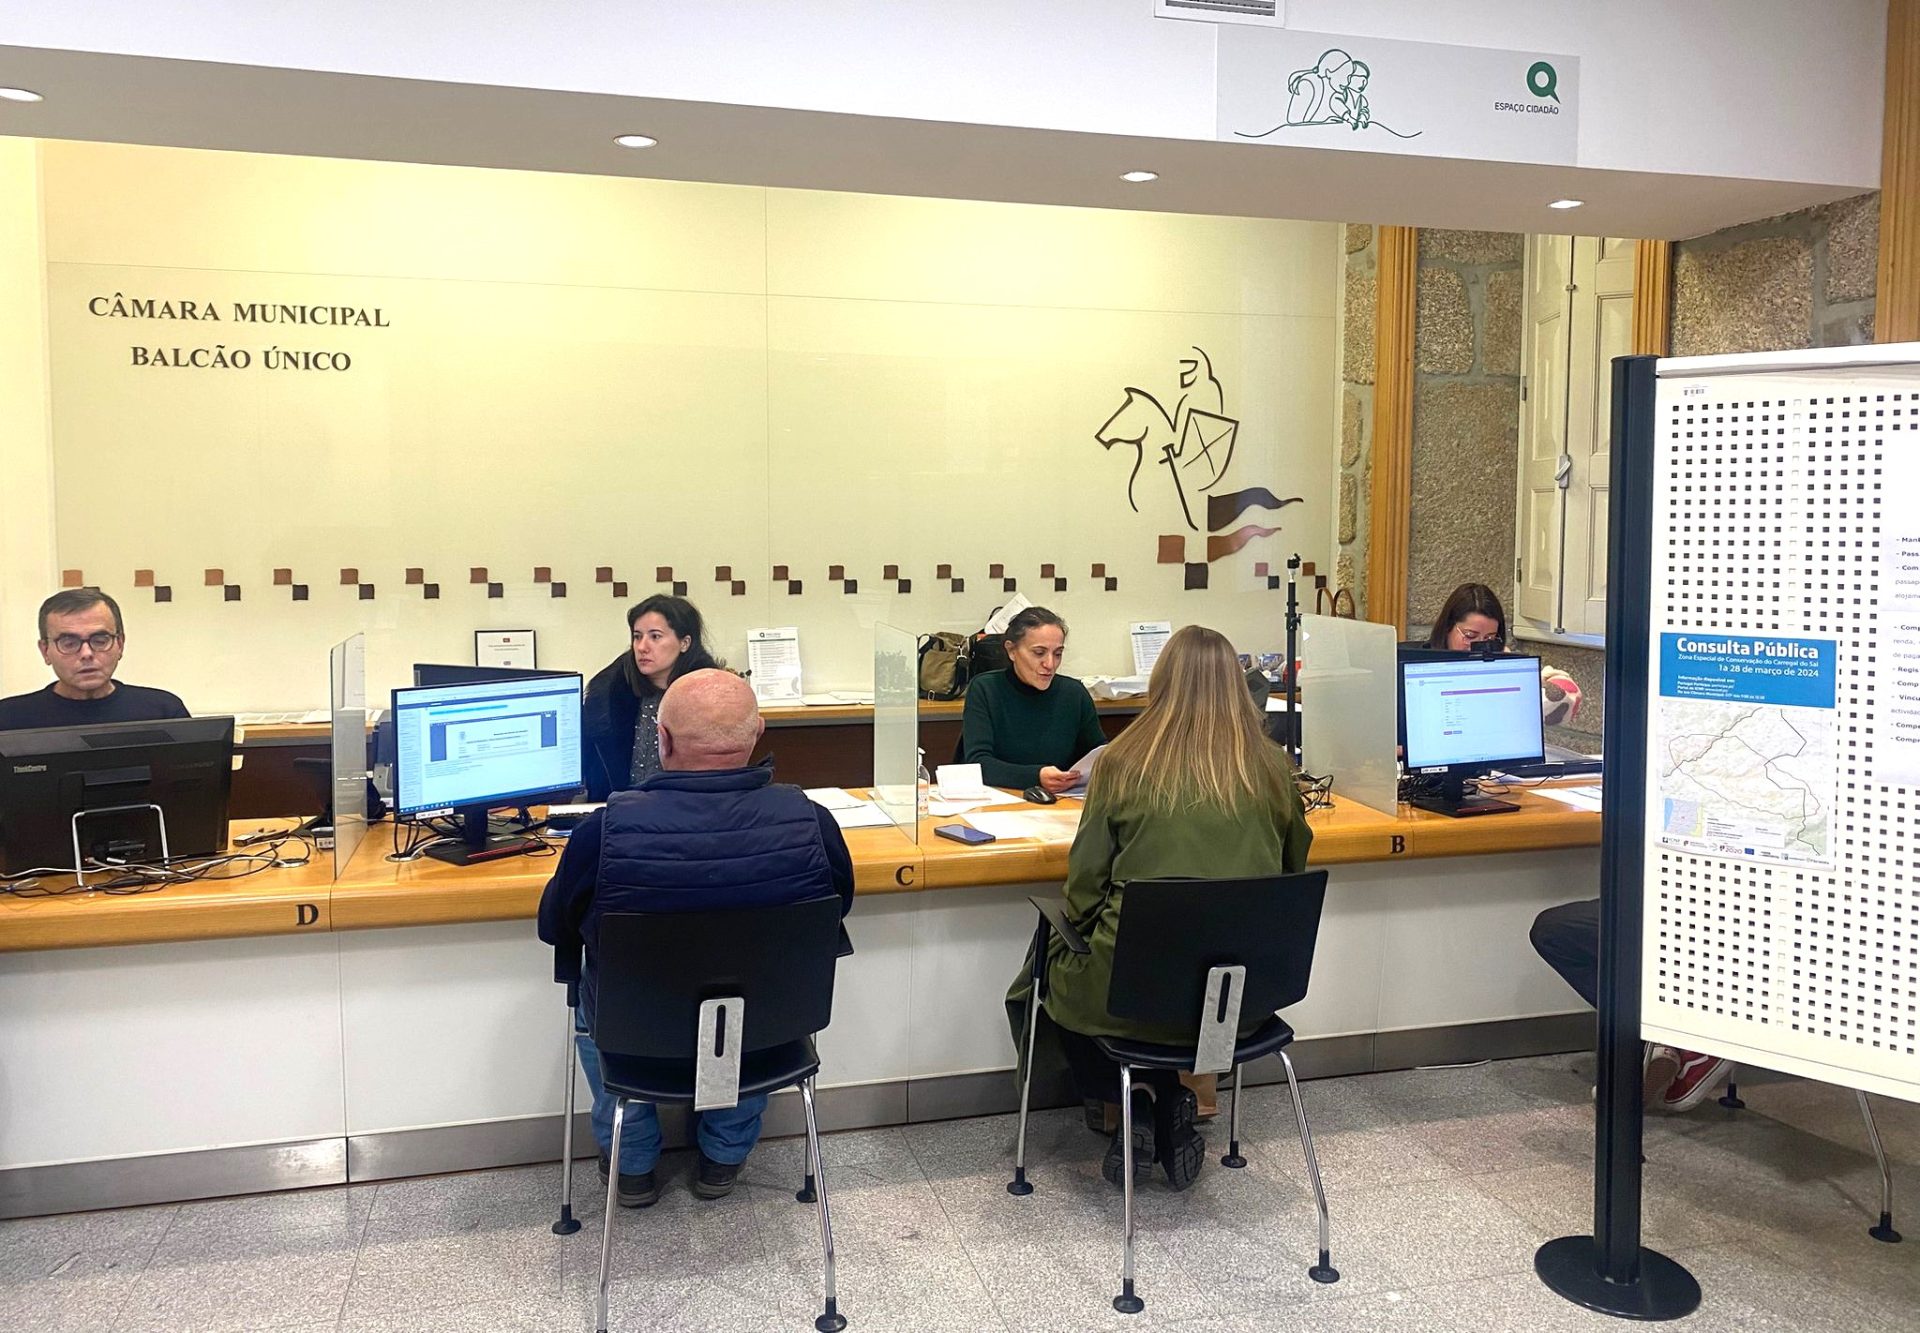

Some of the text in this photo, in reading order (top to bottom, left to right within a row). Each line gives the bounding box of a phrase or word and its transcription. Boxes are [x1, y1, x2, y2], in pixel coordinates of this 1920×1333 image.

[1495, 102, 1559, 115] ESPAÇO CIDADÃO
[88, 292, 391, 328] CÂMARA MUNICIPAL
[131, 344, 352, 372] BALCÃO ÚNICO
[1676, 637, 1819, 659] Consulta Pública
[1693, 654, 1717, 662] Especial
[1725, 656, 1763, 666] Conservação
[1773, 660, 1799, 668] Carregal
[1729, 665, 1741, 673] 28
[1742, 666, 1753, 674] de
[1754, 667, 1783, 676] março
[1783, 668, 1796, 676] de
[1797, 668, 1819, 677] 2024
[1390, 835, 1405, 854] B
[895, 865, 915, 886] C
[296, 903, 319, 926] D
